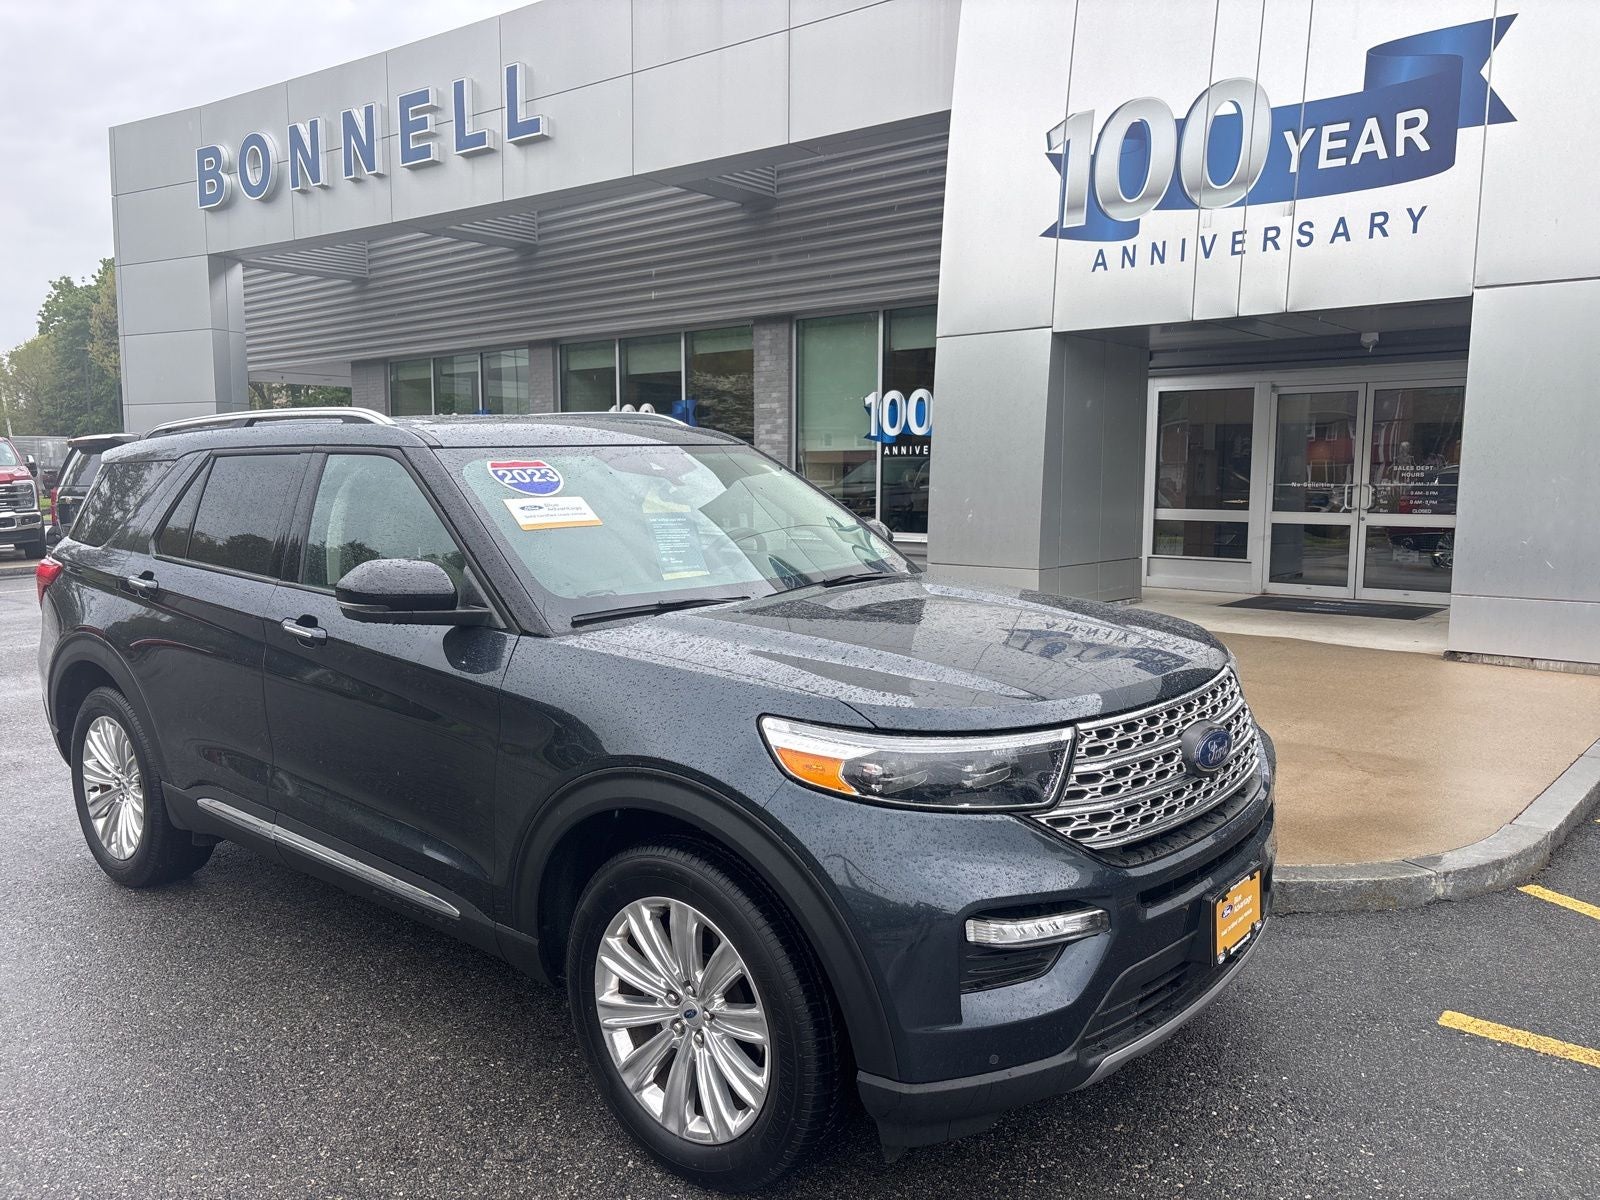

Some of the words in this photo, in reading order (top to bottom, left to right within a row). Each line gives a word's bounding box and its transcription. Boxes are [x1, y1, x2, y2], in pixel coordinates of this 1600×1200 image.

[196, 62, 549, 209] BONNELL
[1046, 76, 1272, 229] 100
[1283, 108, 1431, 173] YEAR
[1091, 205, 1429, 272] ANNIVERSARY
[864, 388, 933, 437] 100
[884, 445, 929, 455] ANNIVE
[497, 468, 559, 484] 2023
[1208, 739, 1228, 764] Ford
